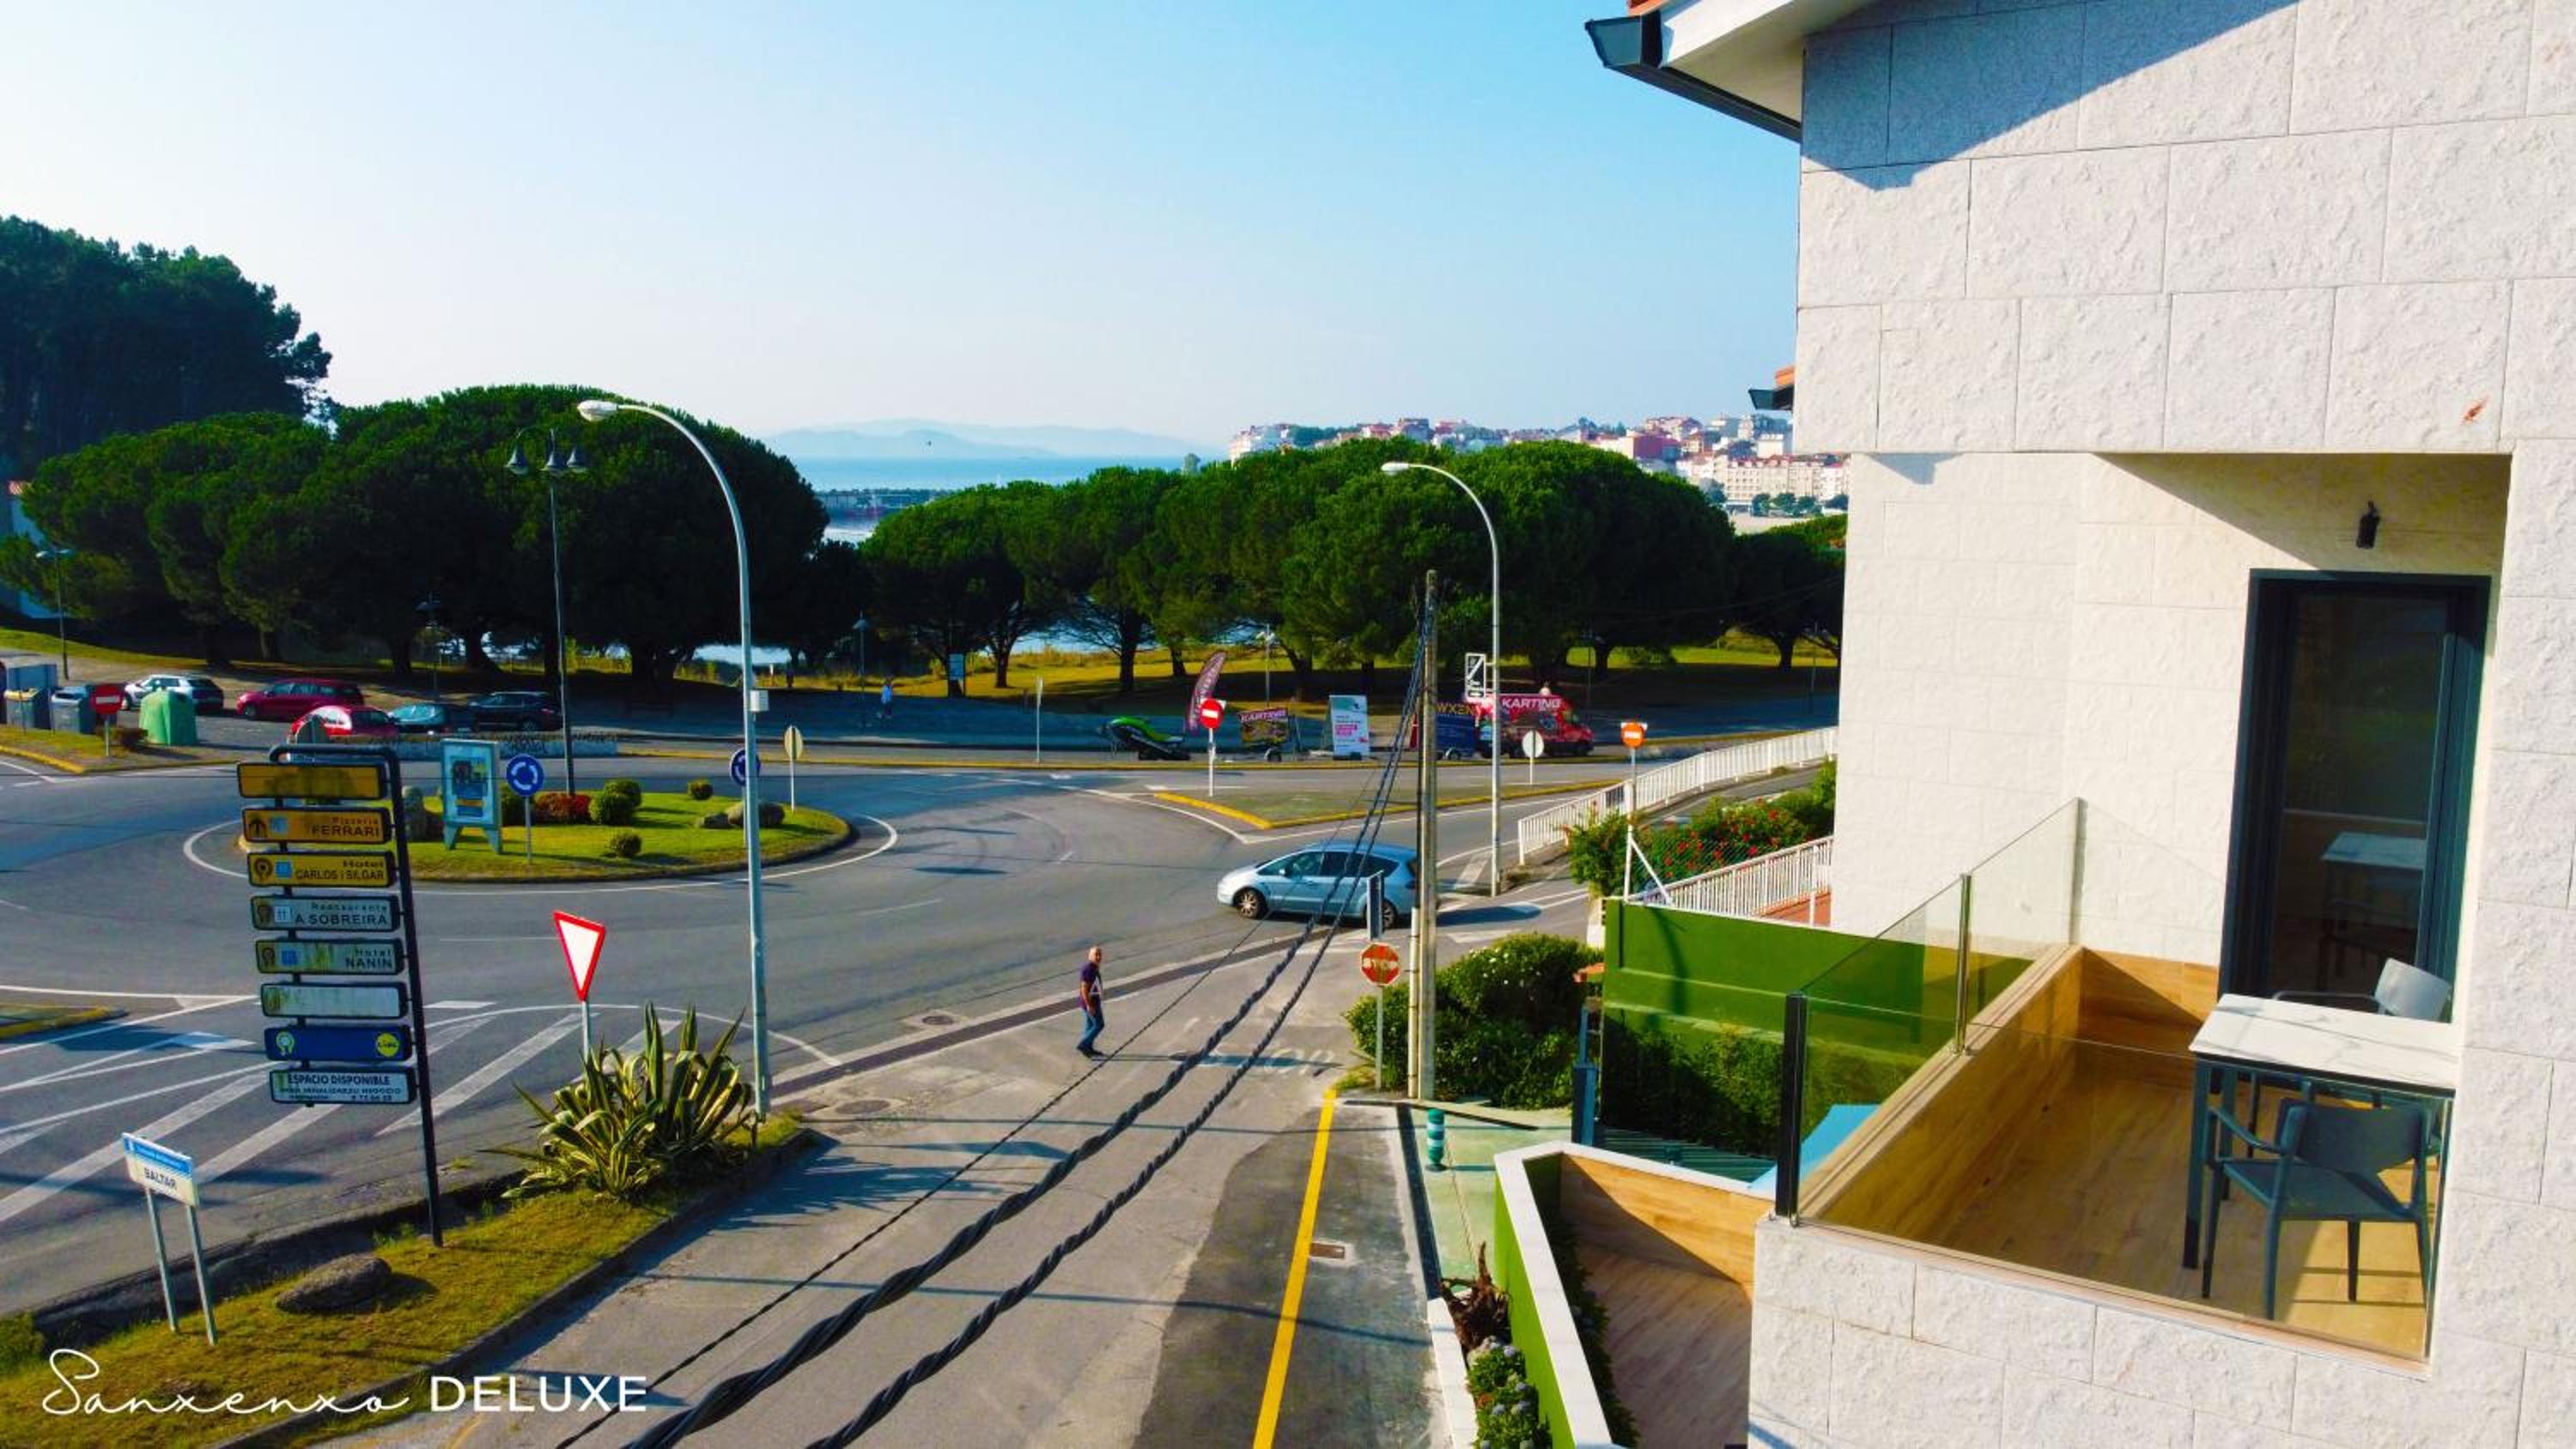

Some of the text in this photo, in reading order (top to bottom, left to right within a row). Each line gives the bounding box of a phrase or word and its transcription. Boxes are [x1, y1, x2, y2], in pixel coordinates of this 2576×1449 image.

[1502, 697, 1562, 711] KARTING
[1241, 708, 1286, 722] KARTING
[312, 825, 380, 838] FERRARI
[295, 869, 338, 881] CARLOS
[295, 914, 387, 925] A SOBREIRA
[288, 1075, 391, 1085] ESPACIO DISPONIBLE
